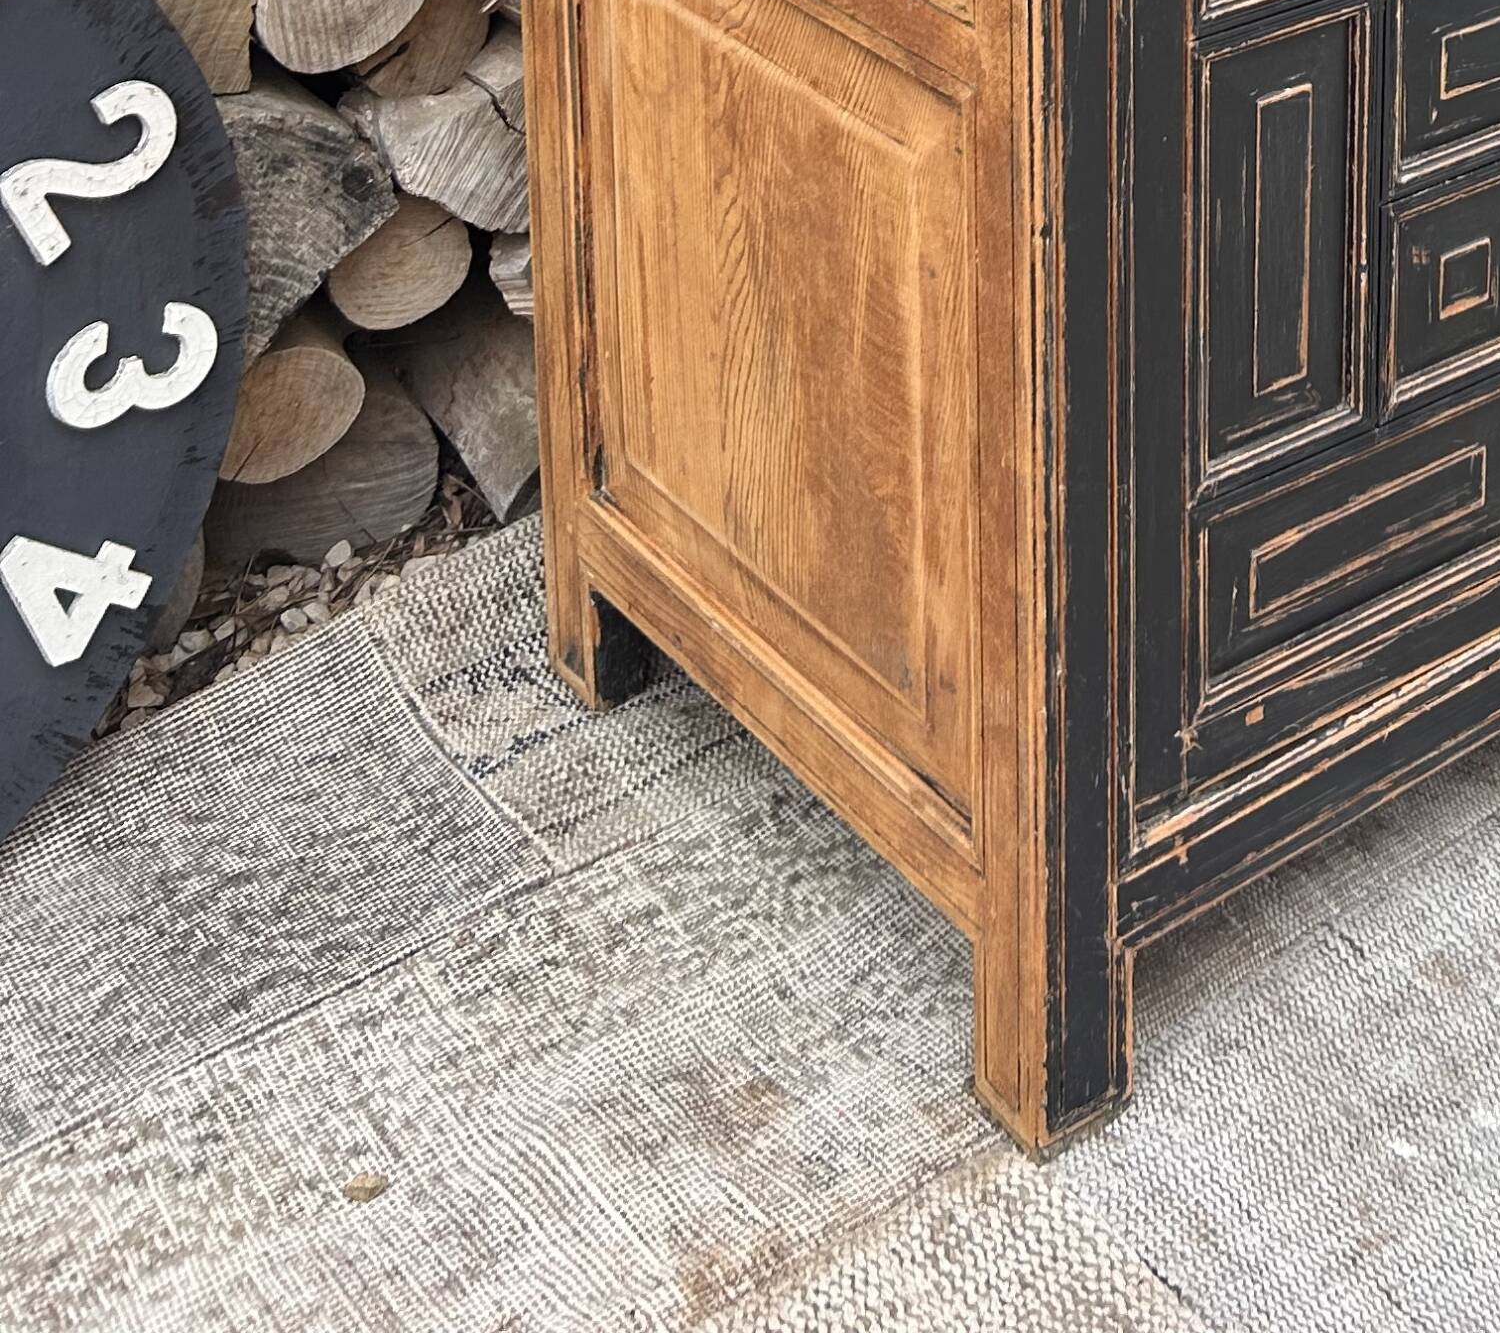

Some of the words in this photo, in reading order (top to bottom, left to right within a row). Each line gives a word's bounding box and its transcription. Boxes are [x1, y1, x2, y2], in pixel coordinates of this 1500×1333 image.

[0, 79, 178, 266] 2
[45, 301, 218, 429] 3
[0, 535, 153, 668] 4
